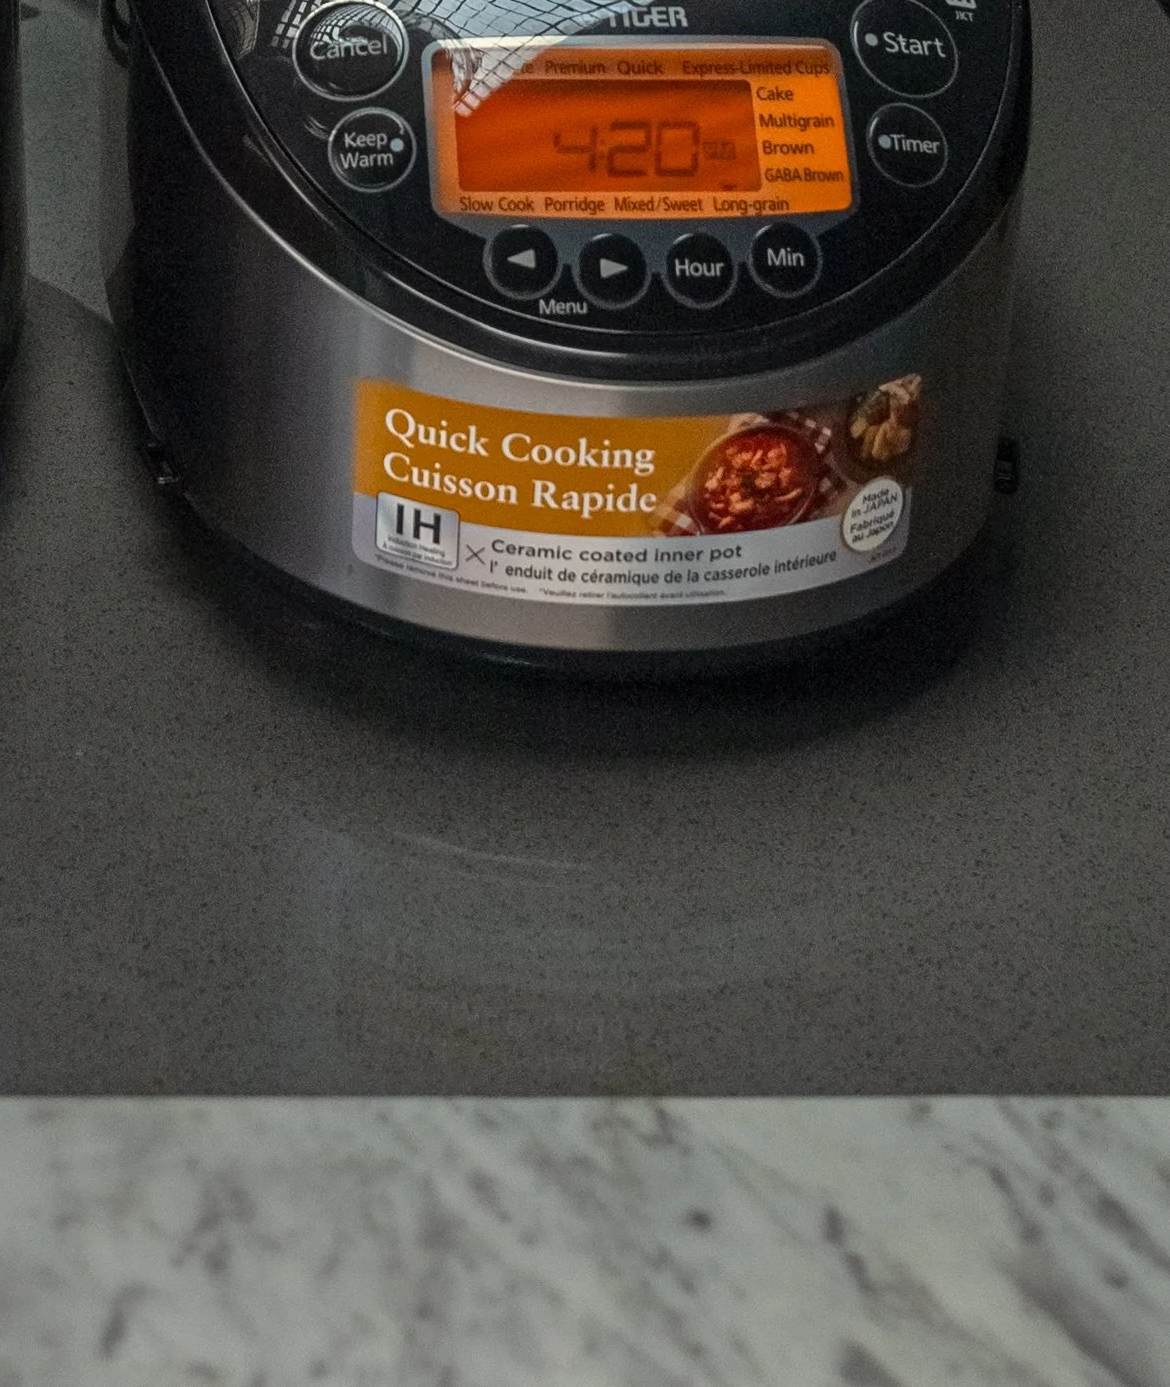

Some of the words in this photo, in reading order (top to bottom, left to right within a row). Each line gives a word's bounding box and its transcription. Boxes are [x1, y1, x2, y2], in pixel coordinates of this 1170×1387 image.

[310, 33, 388, 61] Cancel
[883, 31, 946, 58] Start
[544, 61, 606, 75] Premium
[617, 60, 664, 75] Quick
[795, 61, 830, 79] Cups
[756, 86, 794, 101] Cake
[759, 113, 834, 131] Multigrain
[344, 132, 388, 150] Keep
[762, 140, 814, 155] Brown
[890, 133, 940, 154] Timer
[340, 152, 394, 169] Warm
[764, 168, 801, 183] GABA
[804, 168, 844, 183] Brown
[459, 196, 494, 211] Slow
[498, 196, 535, 211] Cook
[544, 196, 605, 213] Porridge
[614, 196, 704, 213] Mixed/Sweet
[713, 197, 790, 215] Long-grain
[675, 257, 725, 277] Hour
[767, 247, 805, 267] Min
[538, 299, 588, 315] Menu
[385, 408, 490, 457] Quick
[501, 432, 656, 477] Cooking
[383, 451, 519, 506] Cuisson
[531, 479, 657, 520] Rapide
[862, 487, 890, 504] Made
[863, 492, 898, 515] JAPAN
[395, 503, 442, 545] IH
[491, 539, 573, 560] Ceramic
[578, 546, 648, 563] coated
[653, 547, 704, 563] inner
[709, 544, 742, 565] pot
[505, 563, 553, 581] enduit
[557, 569, 576, 583] de
[581, 569, 660, 587] céramique
[663, 570, 683, 584] de
[686, 570, 700, 583] la
[703, 564, 770, 583] casserole
[774, 550, 837, 574] intérieure
